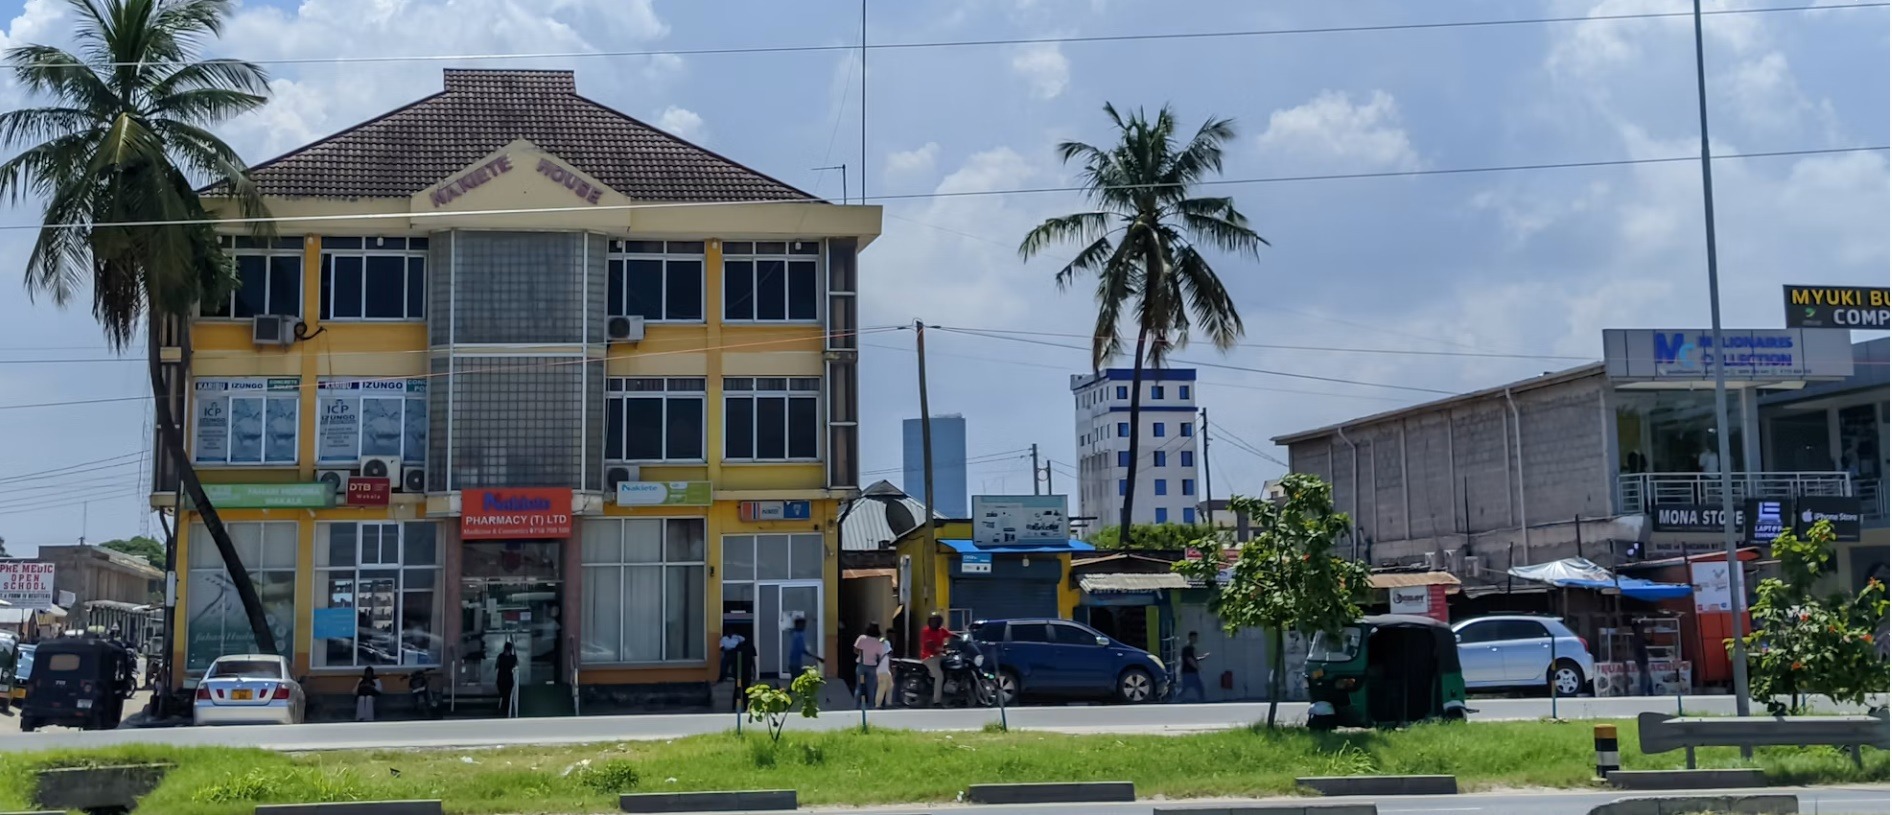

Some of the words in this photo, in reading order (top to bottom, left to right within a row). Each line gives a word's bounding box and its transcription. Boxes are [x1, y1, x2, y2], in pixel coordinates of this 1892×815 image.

[430, 153, 514, 208] NAKIETE
[536, 157, 604, 206] HOUSE
[1792, 289, 1862, 306] MYUKI
[1698, 335, 1793, 349] MILIONAIRES
[1702, 353, 1792, 367] CLLECTION
[204, 407, 222, 417] ICP
[327, 405, 350, 414] ICP
[350, 483, 372, 491] DTB
[465, 515, 528, 526] PHARMACY
[530, 515, 545, 526] (T)
[547, 514, 567, 524] LTD
[1659, 509, 1698, 525] MONA
[1702, 510, 1744, 525] STOE
[1814, 512, 1837, 521] iPhone
[1839, 513, 1858, 521] Store
[22, 564, 53, 574] MEDIC
[11, 574, 40, 582] OPEN
[3, 582, 46, 590] SCHOOL
